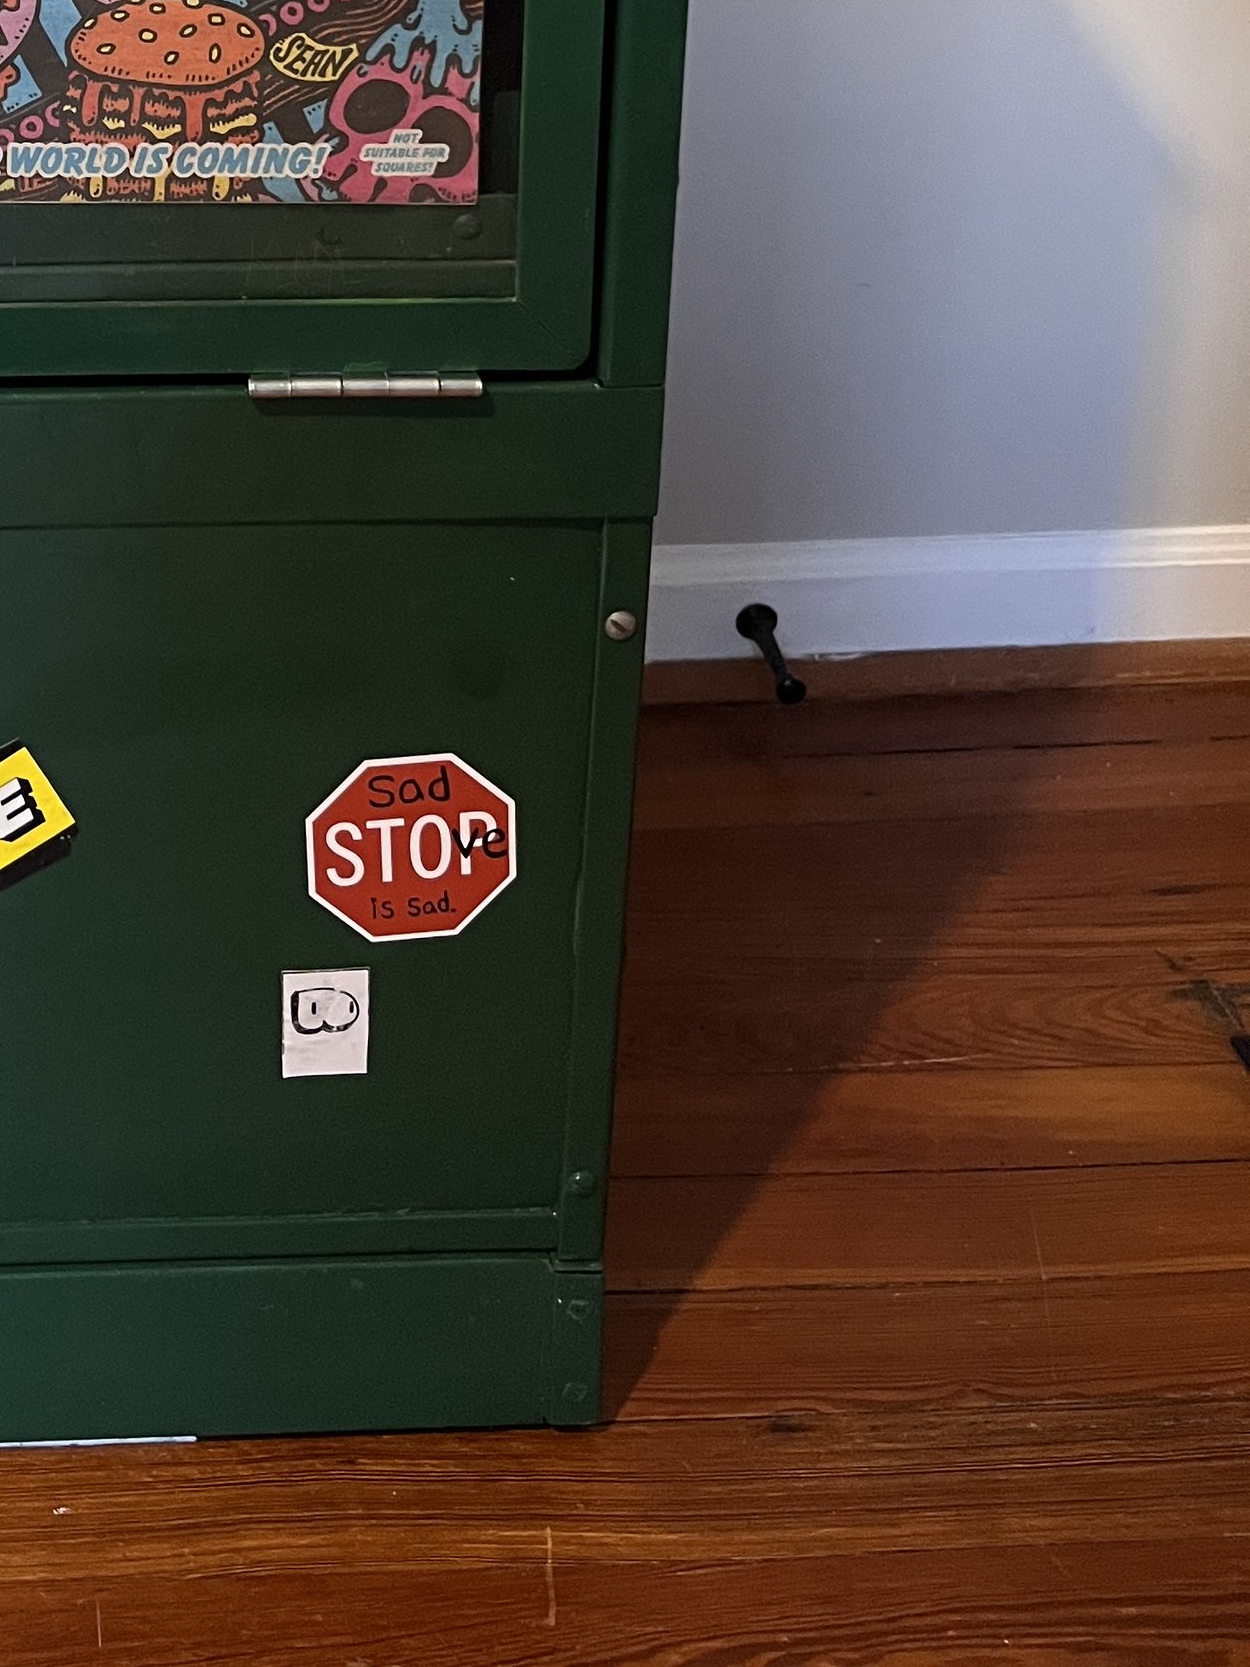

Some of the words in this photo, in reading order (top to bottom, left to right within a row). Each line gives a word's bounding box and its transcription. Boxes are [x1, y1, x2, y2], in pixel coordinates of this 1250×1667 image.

[272, 35, 354, 79] SEAN
[364, 147, 420, 158] SUITABLE
[393, 133, 419, 144] NOT
[10, 146, 127, 176] WORLD
[134, 146, 168, 175] IS
[175, 146, 329, 175] COMING!
[368, 765, 451, 808] Sad
[325, 810, 498, 887] STOP
[370, 897, 395, 920] is
